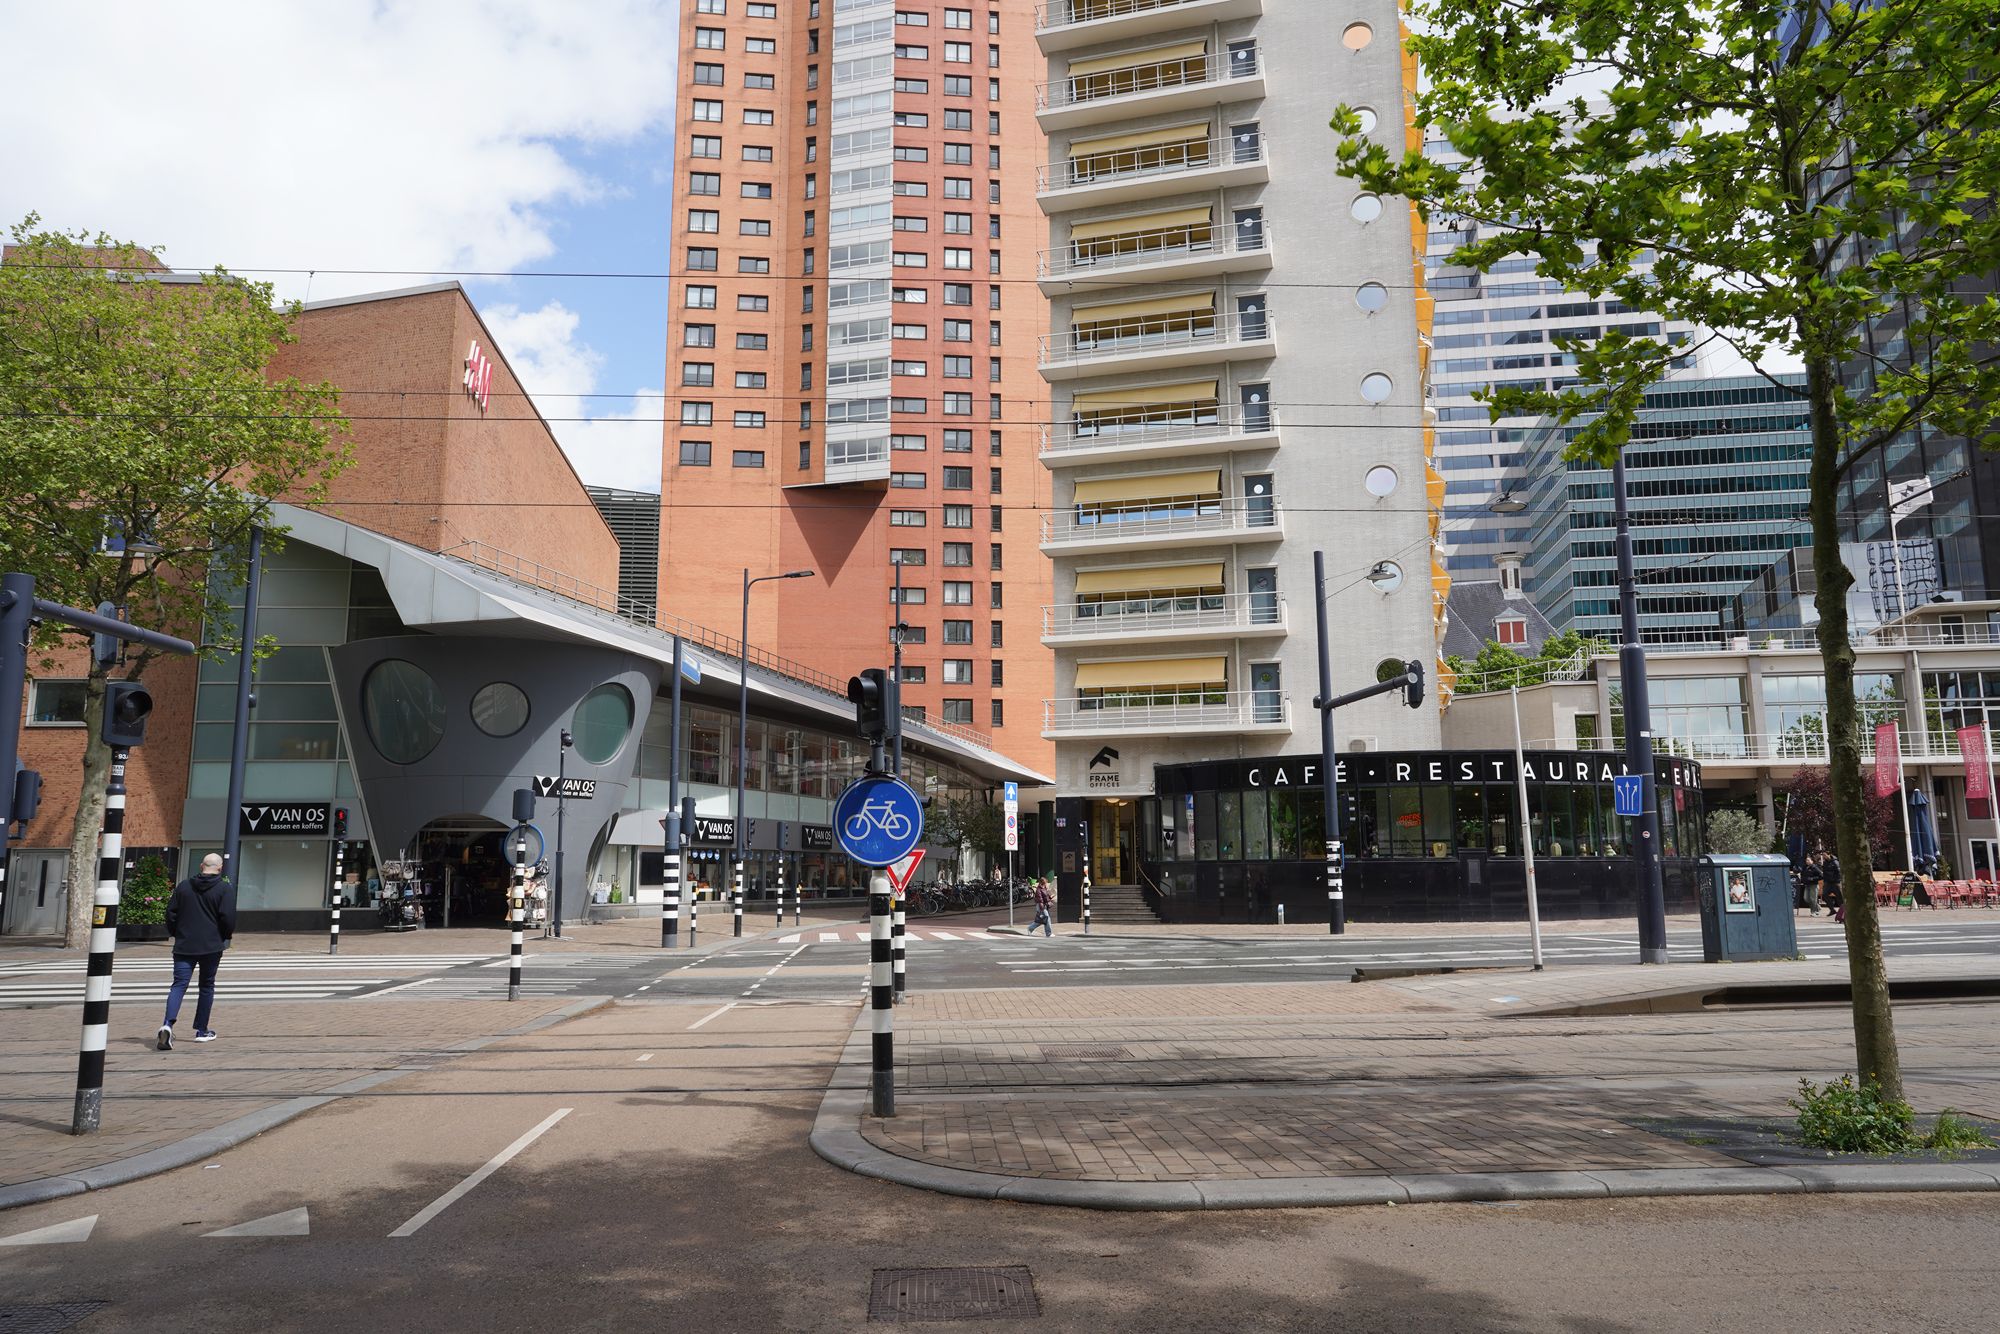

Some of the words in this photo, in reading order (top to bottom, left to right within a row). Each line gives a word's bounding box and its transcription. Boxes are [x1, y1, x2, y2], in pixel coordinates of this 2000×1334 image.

[1249, 761, 1347, 786] CAFÉ
[1396, 761, 1628, 782] RESTAURA
[1673, 767, 1700, 789] ERA
[582, 781, 595, 792] OS
[271, 808, 302, 822] VAN
[305, 808, 325, 822] OS
[708, 822, 722, 834] VAN
[723, 823, 733, 834] OS
[814, 830, 824, 839] VAN
[824, 830, 832, 840] OS
